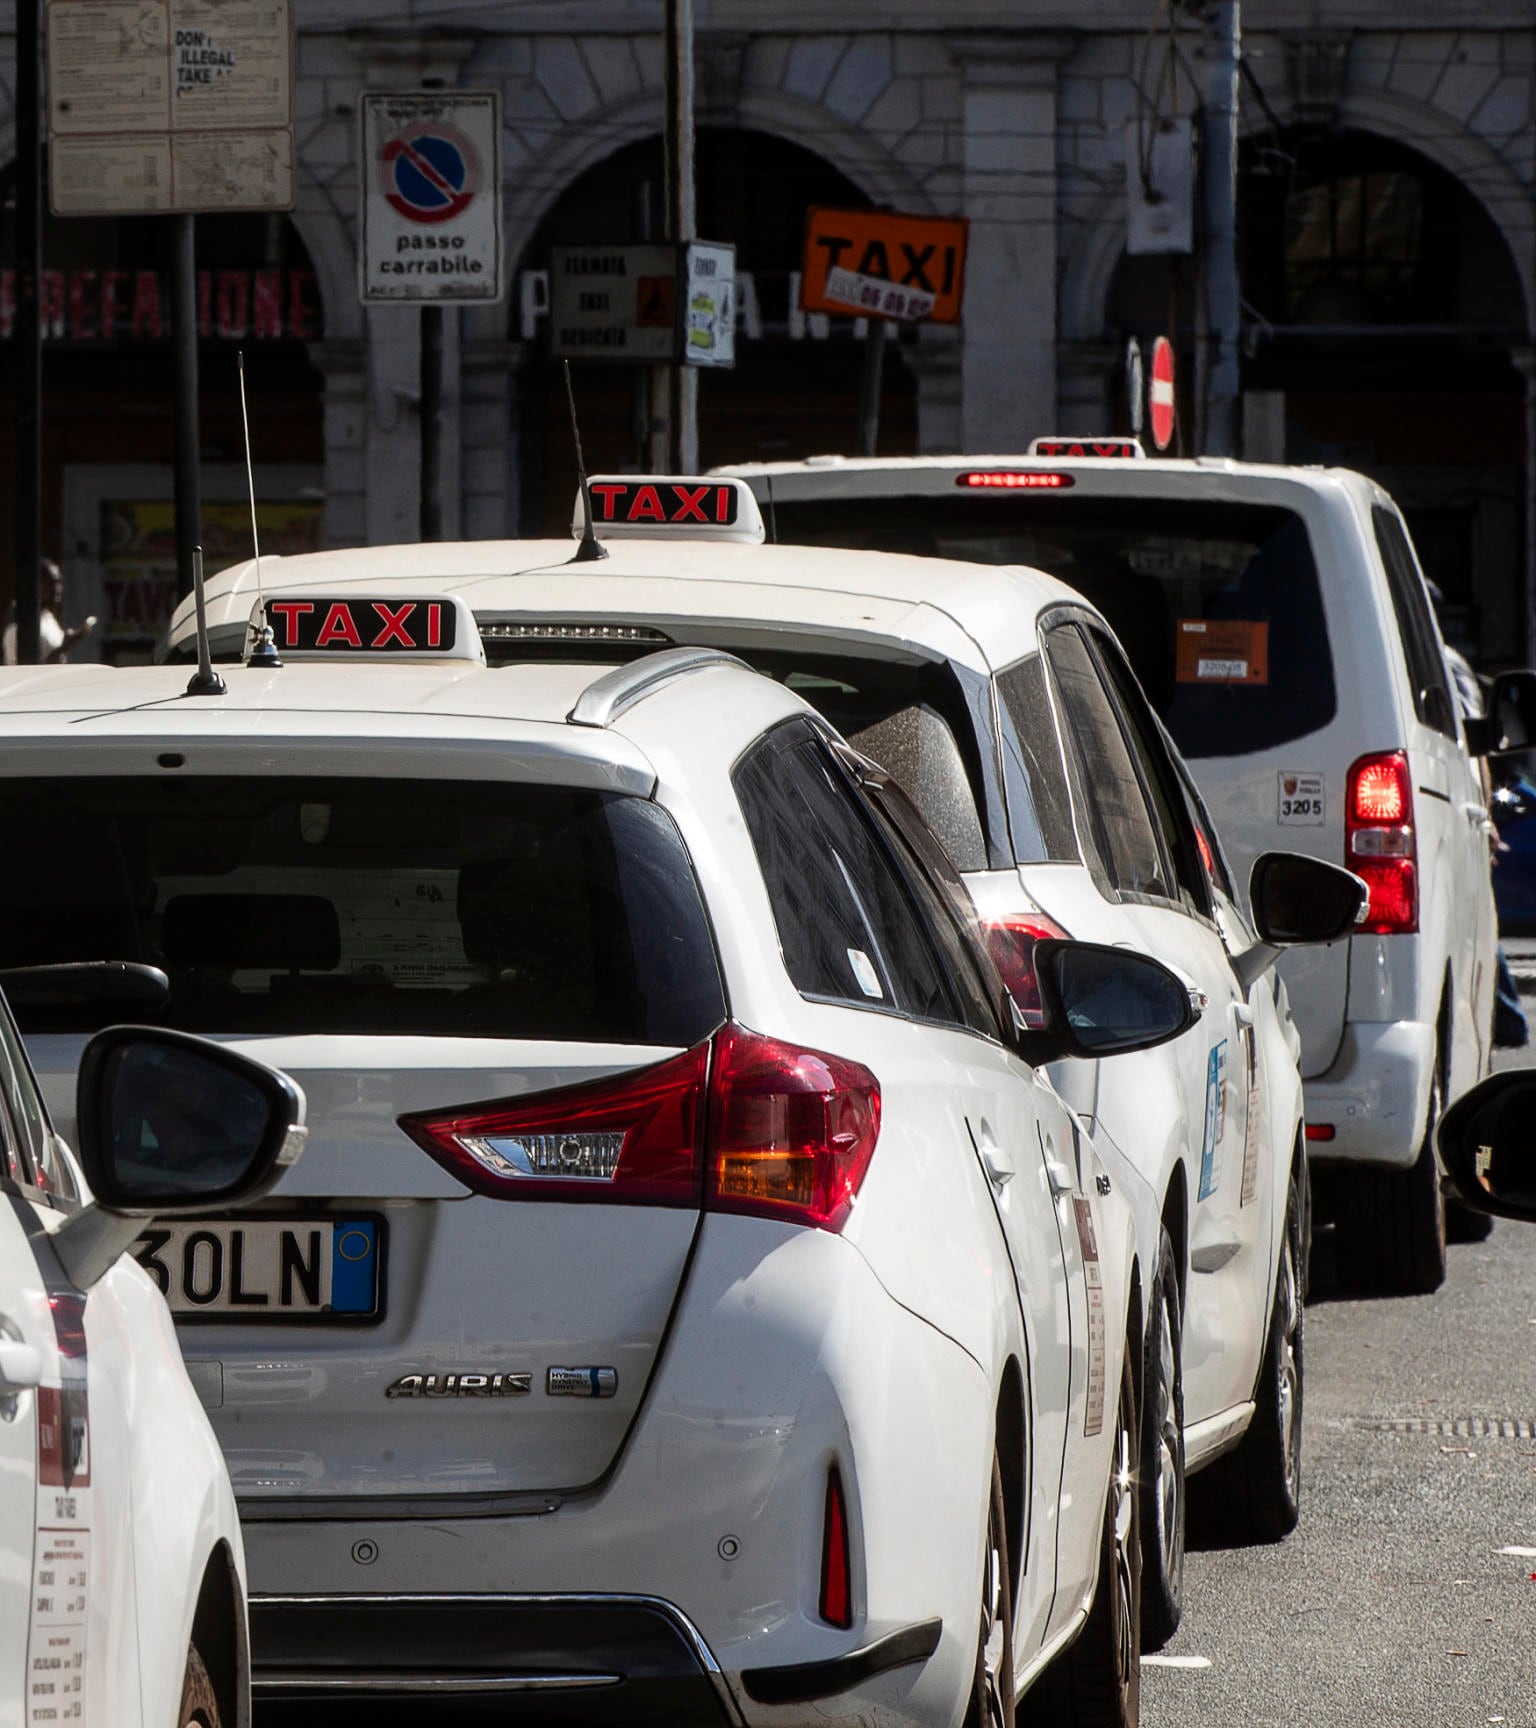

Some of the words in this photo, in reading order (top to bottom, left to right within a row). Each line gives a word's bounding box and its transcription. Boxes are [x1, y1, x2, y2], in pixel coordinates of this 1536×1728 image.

[181, 49, 235, 66] ILLEGAL
[177, 68, 211, 84] TAKE
[396, 235, 464, 252] passo
[380, 256, 482, 273] carrabile
[566, 255, 626, 274] FERMATA
[817, 235, 955, 295] TAXI
[591, 485, 729, 522] TAXI
[272, 603, 441, 647] TAXI
[1282, 800, 1322, 816] 3205
[386, 1373, 532, 1397] AURIS
